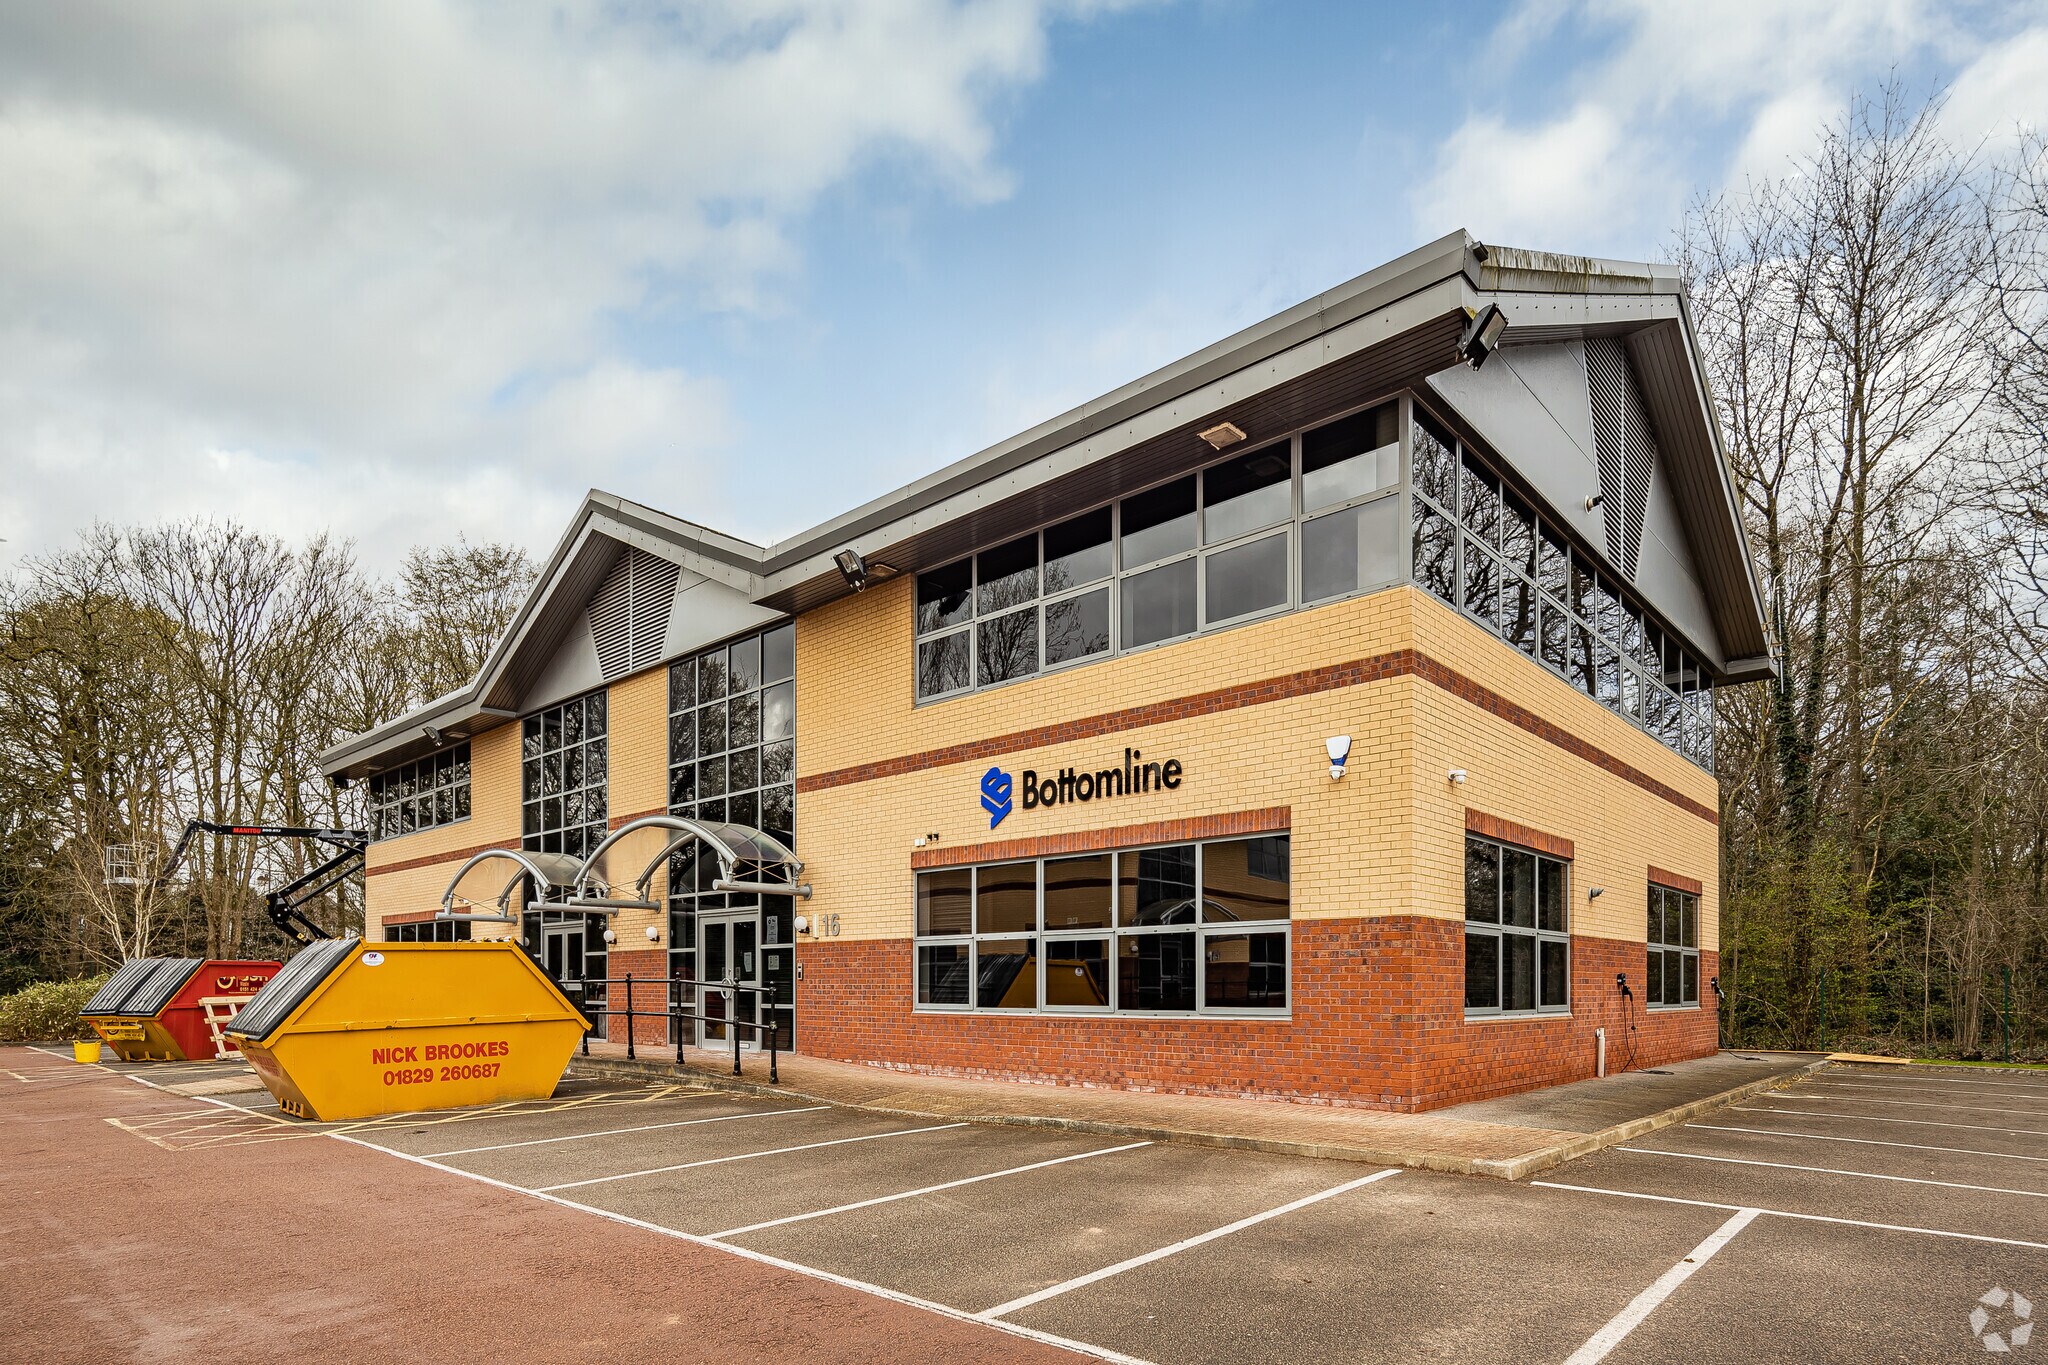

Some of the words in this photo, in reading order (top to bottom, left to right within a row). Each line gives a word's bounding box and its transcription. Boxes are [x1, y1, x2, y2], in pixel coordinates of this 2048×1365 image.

[1022, 747, 1183, 810] Bottomline
[823, 913, 841, 936] 16
[372, 1046, 418, 1064] NICK
[425, 1041, 509, 1061] BROOKES
[383, 1067, 434, 1086] 01829
[440, 1063, 501, 1081] 260687
